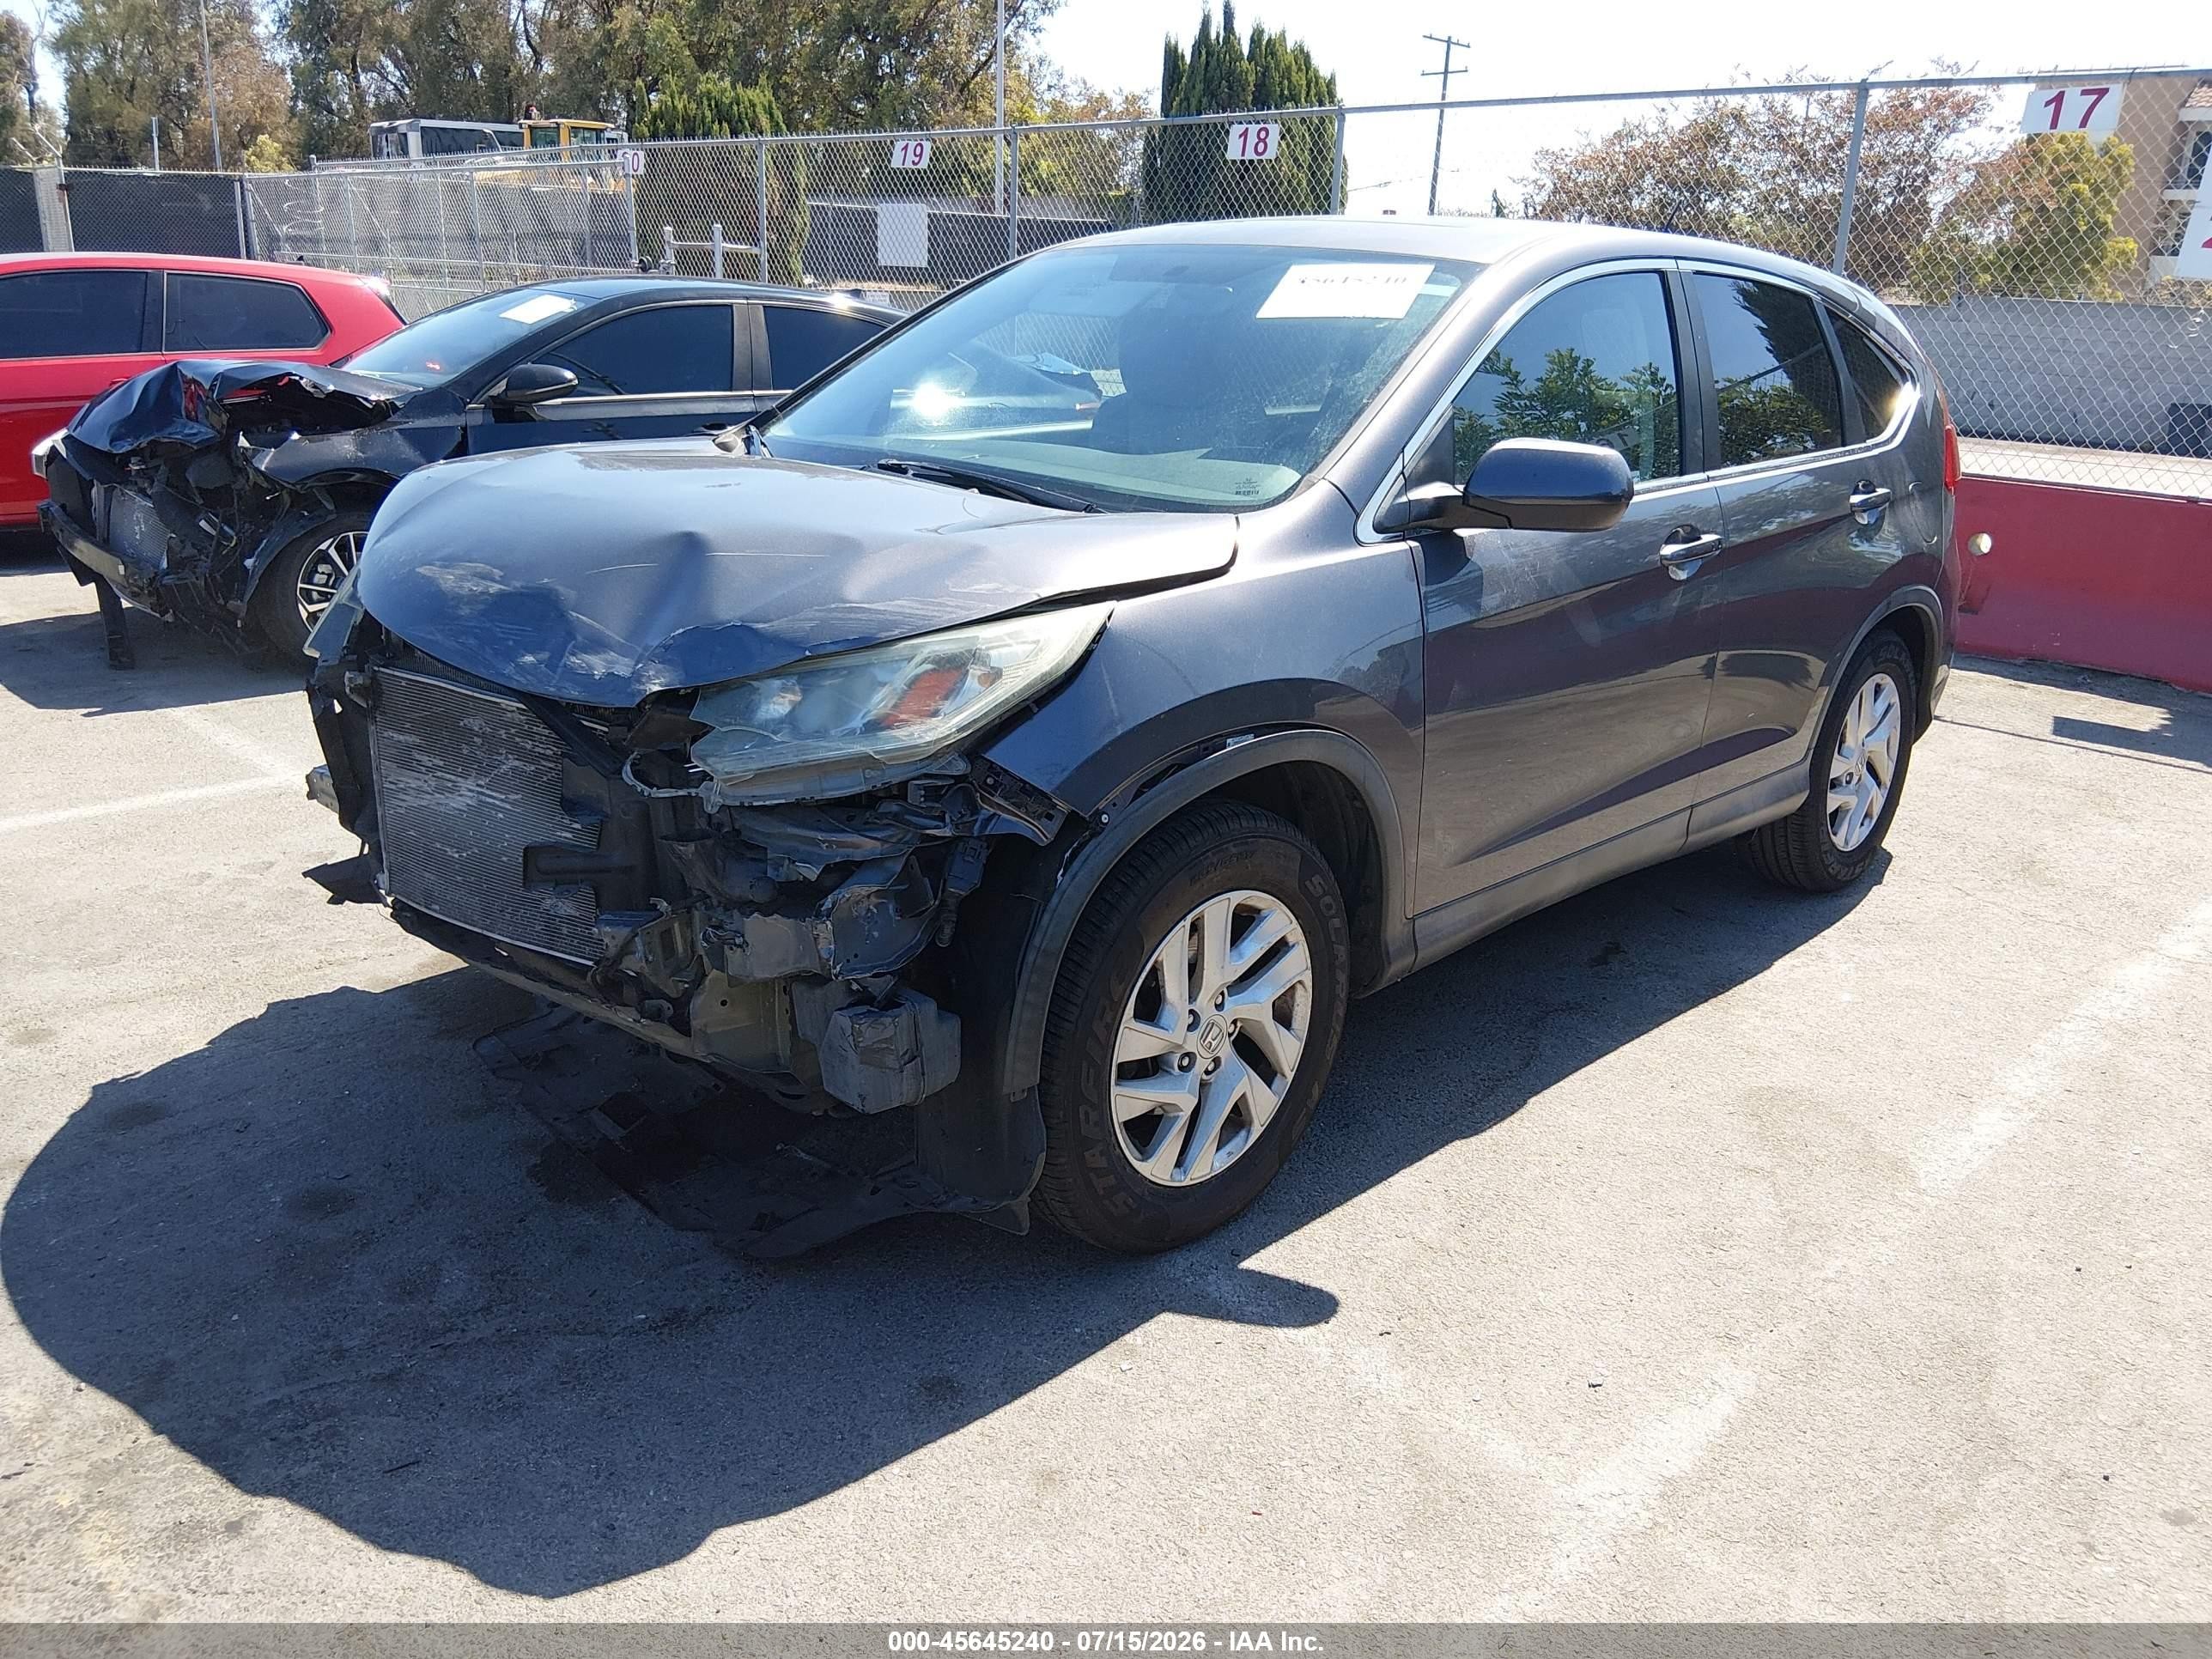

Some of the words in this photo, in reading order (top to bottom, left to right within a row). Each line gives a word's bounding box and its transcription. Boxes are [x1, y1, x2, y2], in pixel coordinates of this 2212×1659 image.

[2044, 87, 2110, 131] 17
[901, 142, 924, 167] 19
[1238, 126, 1270, 157] 18
[622, 151, 640, 173] 0
[1304, 872, 1347, 1062] SOLARUS
